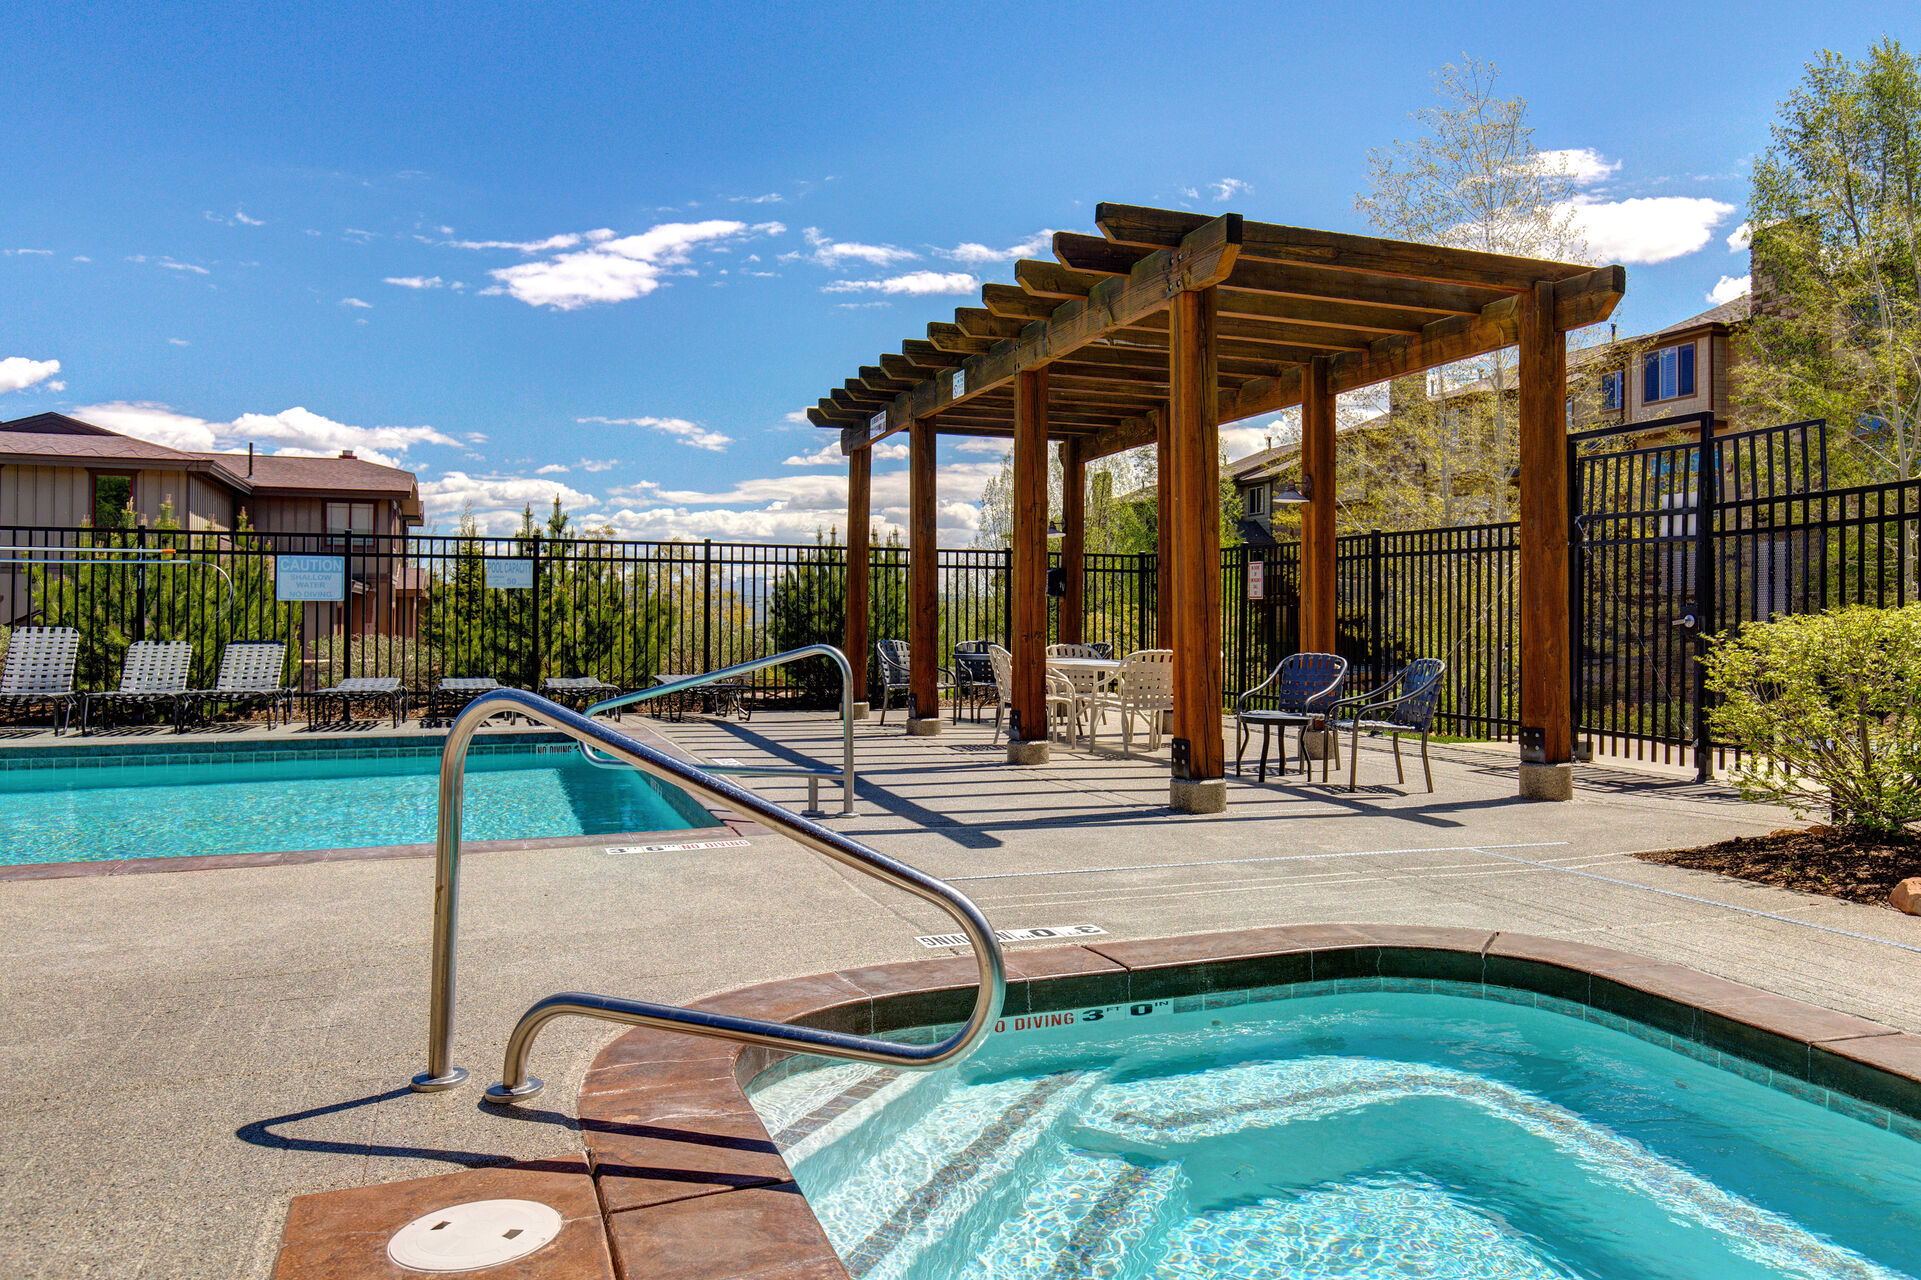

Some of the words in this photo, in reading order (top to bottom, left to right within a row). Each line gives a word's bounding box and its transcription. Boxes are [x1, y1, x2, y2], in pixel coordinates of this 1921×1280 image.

[280, 559, 342, 571] CAUTION
[487, 562, 503, 573] POOL
[504, 562, 532, 574] CAPACITY
[290, 573, 332, 581] SHALLOW
[295, 581, 327, 589] WATER
[704, 840, 749, 849] DIVING
[1074, 925, 1100, 934] 3
[921, 934, 971, 947] IVING
[994, 1020, 1006, 1033] O
[1014, 1012, 1075, 1031] DIVING
[1082, 1009, 1104, 1022] 3
[1130, 1003, 1153, 1016] 0
